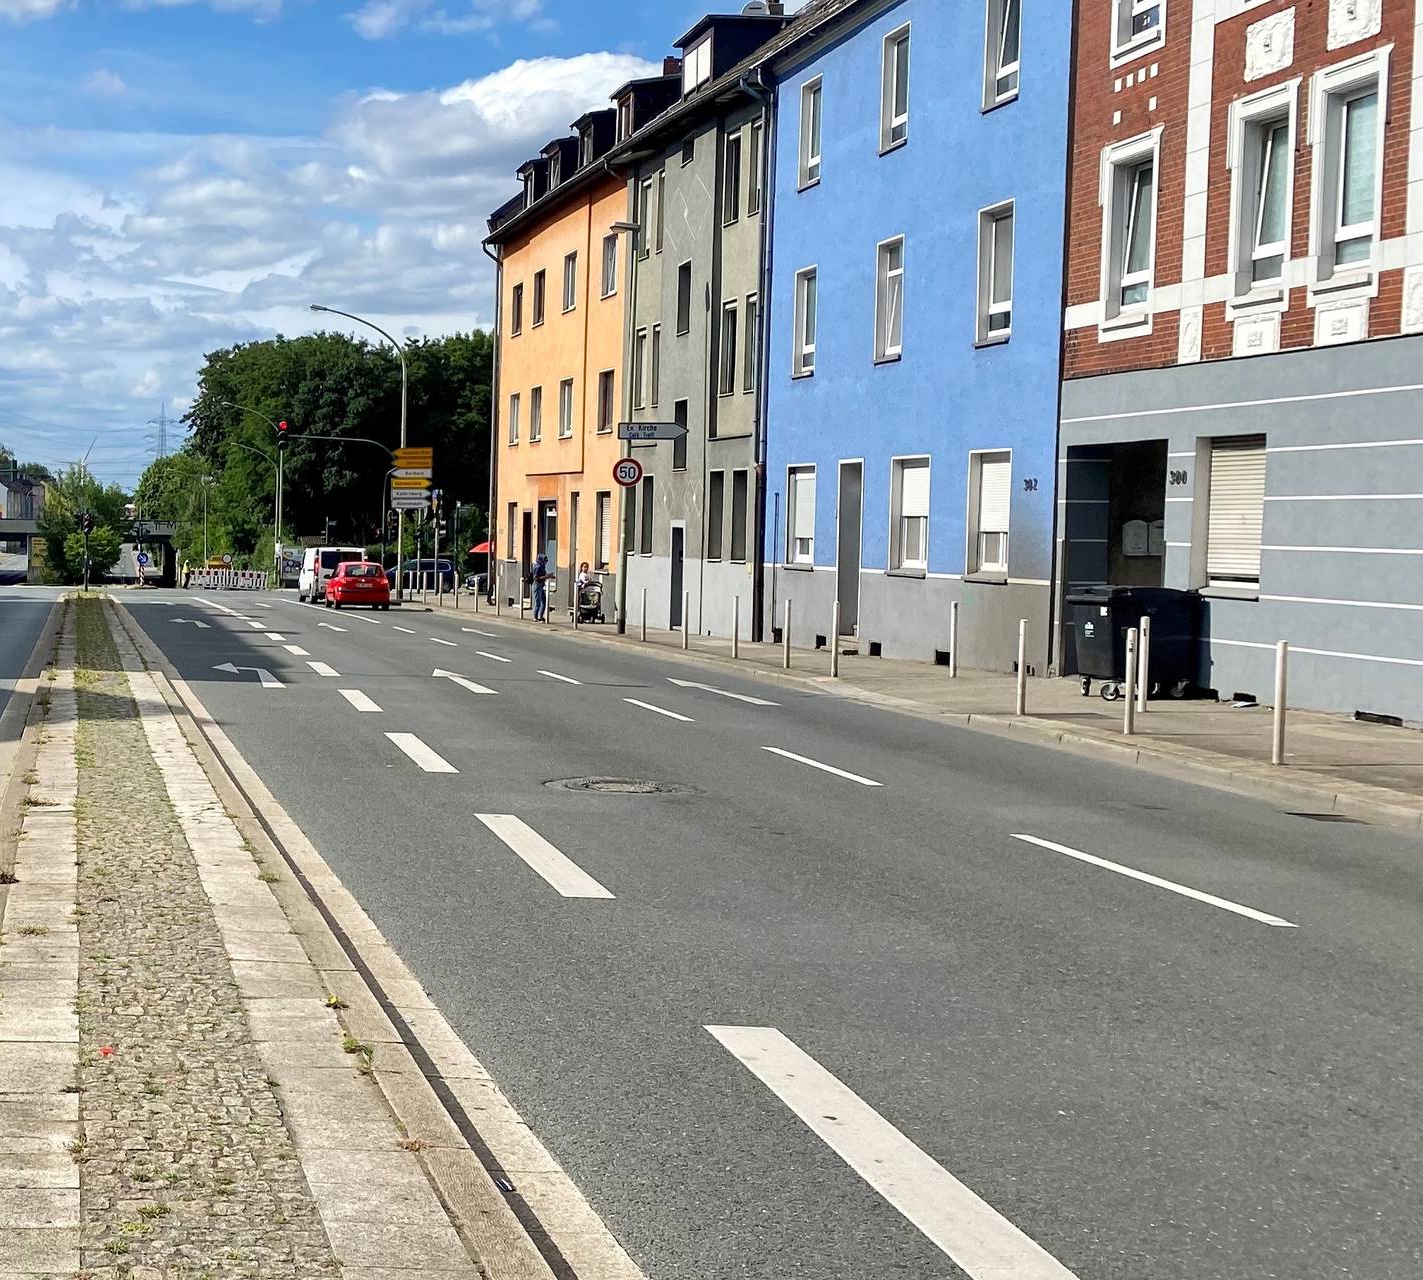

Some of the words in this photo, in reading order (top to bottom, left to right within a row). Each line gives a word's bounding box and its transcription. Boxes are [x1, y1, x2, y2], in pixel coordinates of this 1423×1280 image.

[620, 466, 636, 479] 50
[1169, 470, 1188, 485] 300
[1023, 478, 1038, 491] 302
